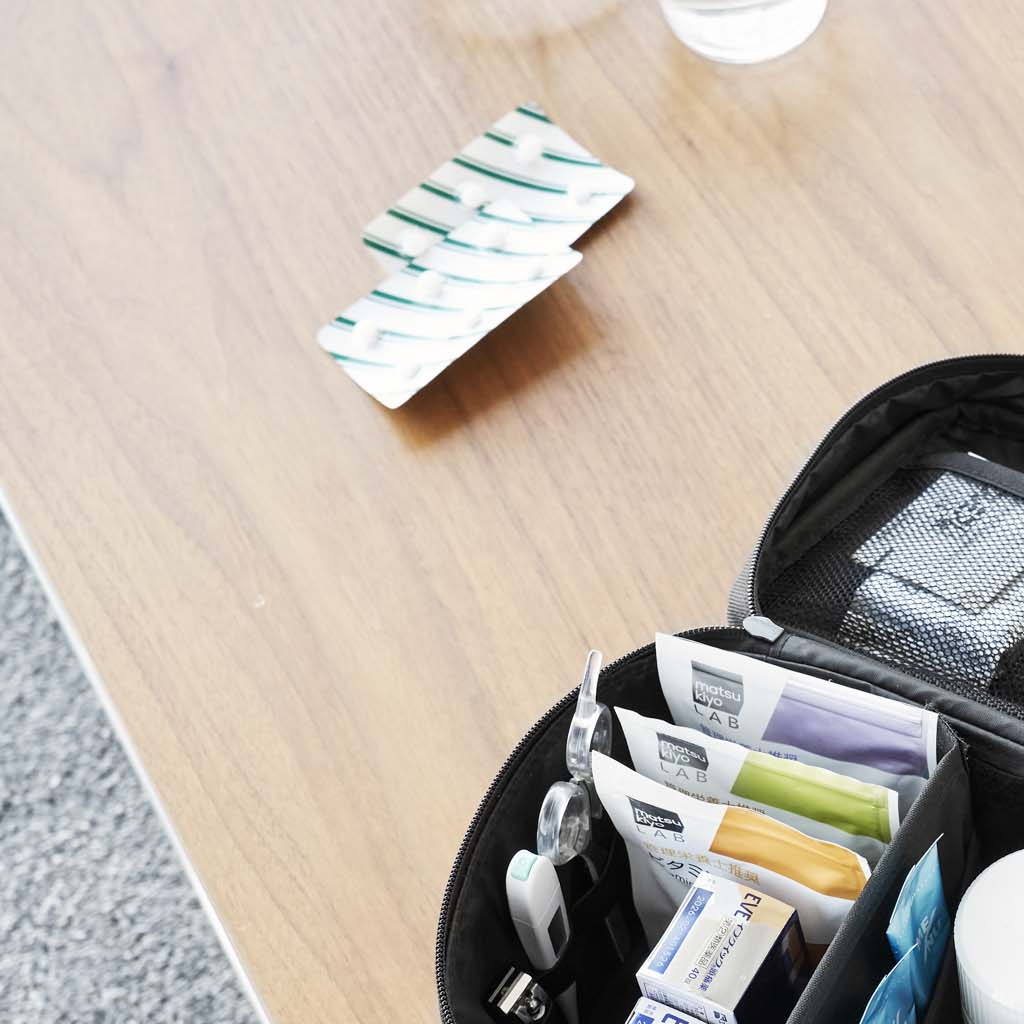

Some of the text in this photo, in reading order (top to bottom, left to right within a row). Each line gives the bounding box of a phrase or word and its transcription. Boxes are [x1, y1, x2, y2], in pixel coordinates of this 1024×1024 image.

[695, 680, 742, 703] matsu
[695, 690, 724, 708] kiyo
[662, 740, 706, 764] matsu
[662, 749, 691, 768] kiyo
[635, 809, 682, 828] matsu
[734, 892, 761, 922] EVE
